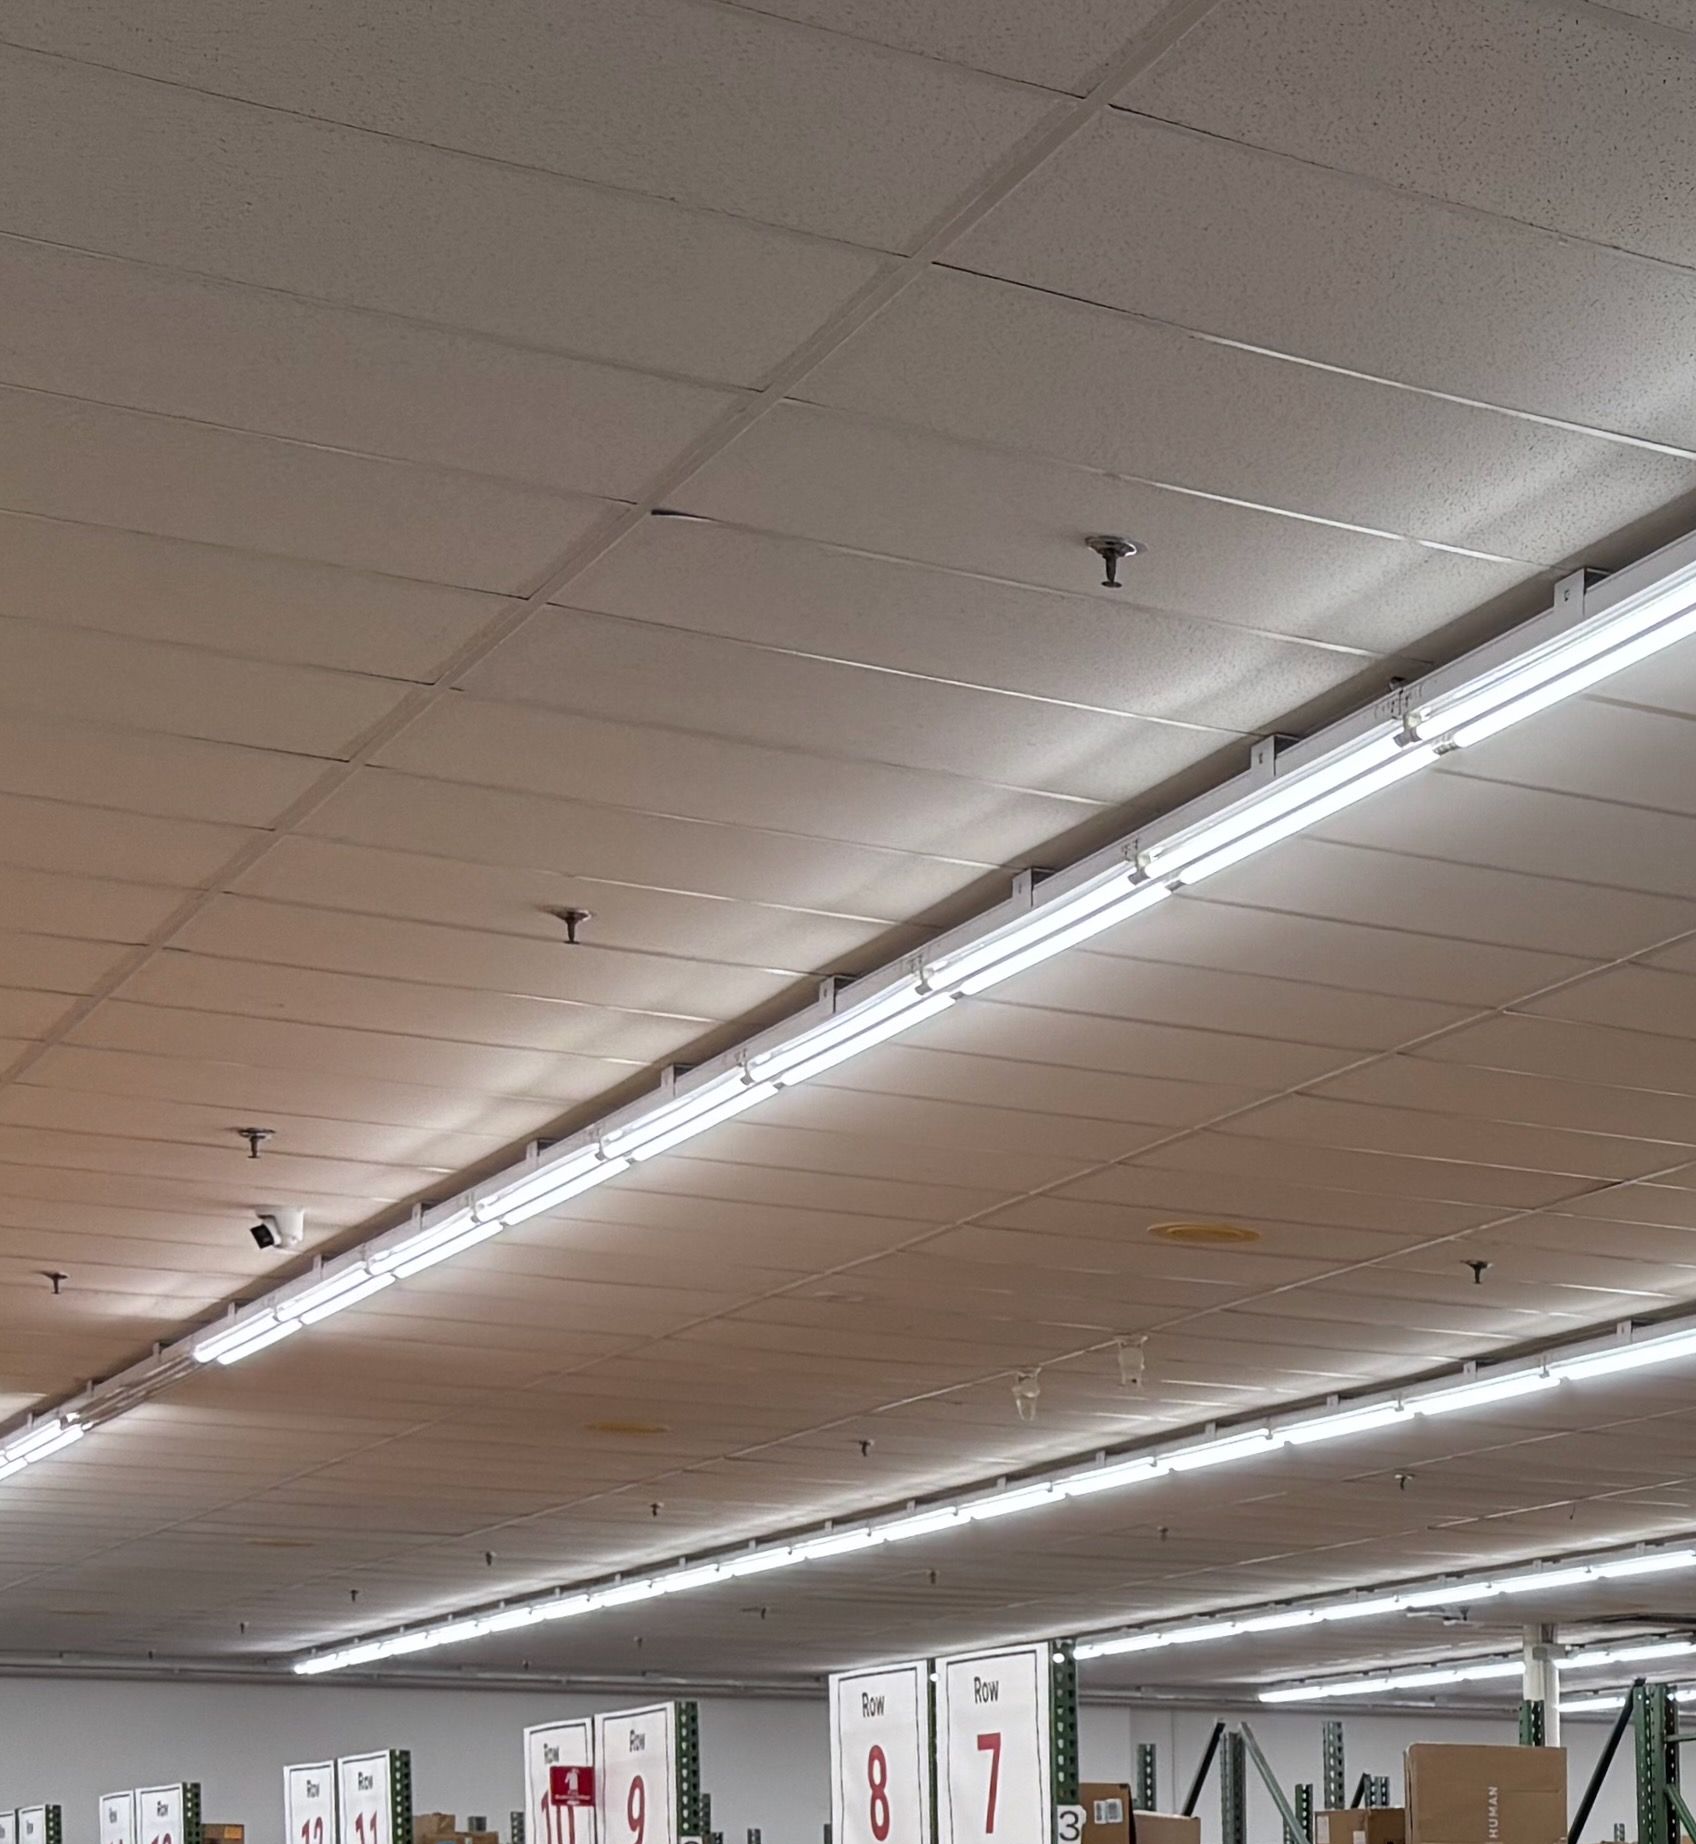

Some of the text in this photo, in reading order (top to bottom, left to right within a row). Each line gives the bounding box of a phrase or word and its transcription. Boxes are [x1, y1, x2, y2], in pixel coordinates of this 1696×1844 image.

[862, 1691, 885, 1718] Row
[974, 1676, 999, 1704] Row
[867, 1744, 890, 1841] 8
[977, 1732, 1001, 1834] 7
[1058, 1810, 1080, 1841] 3
[1487, 1786, 1499, 1838] HUMAN
